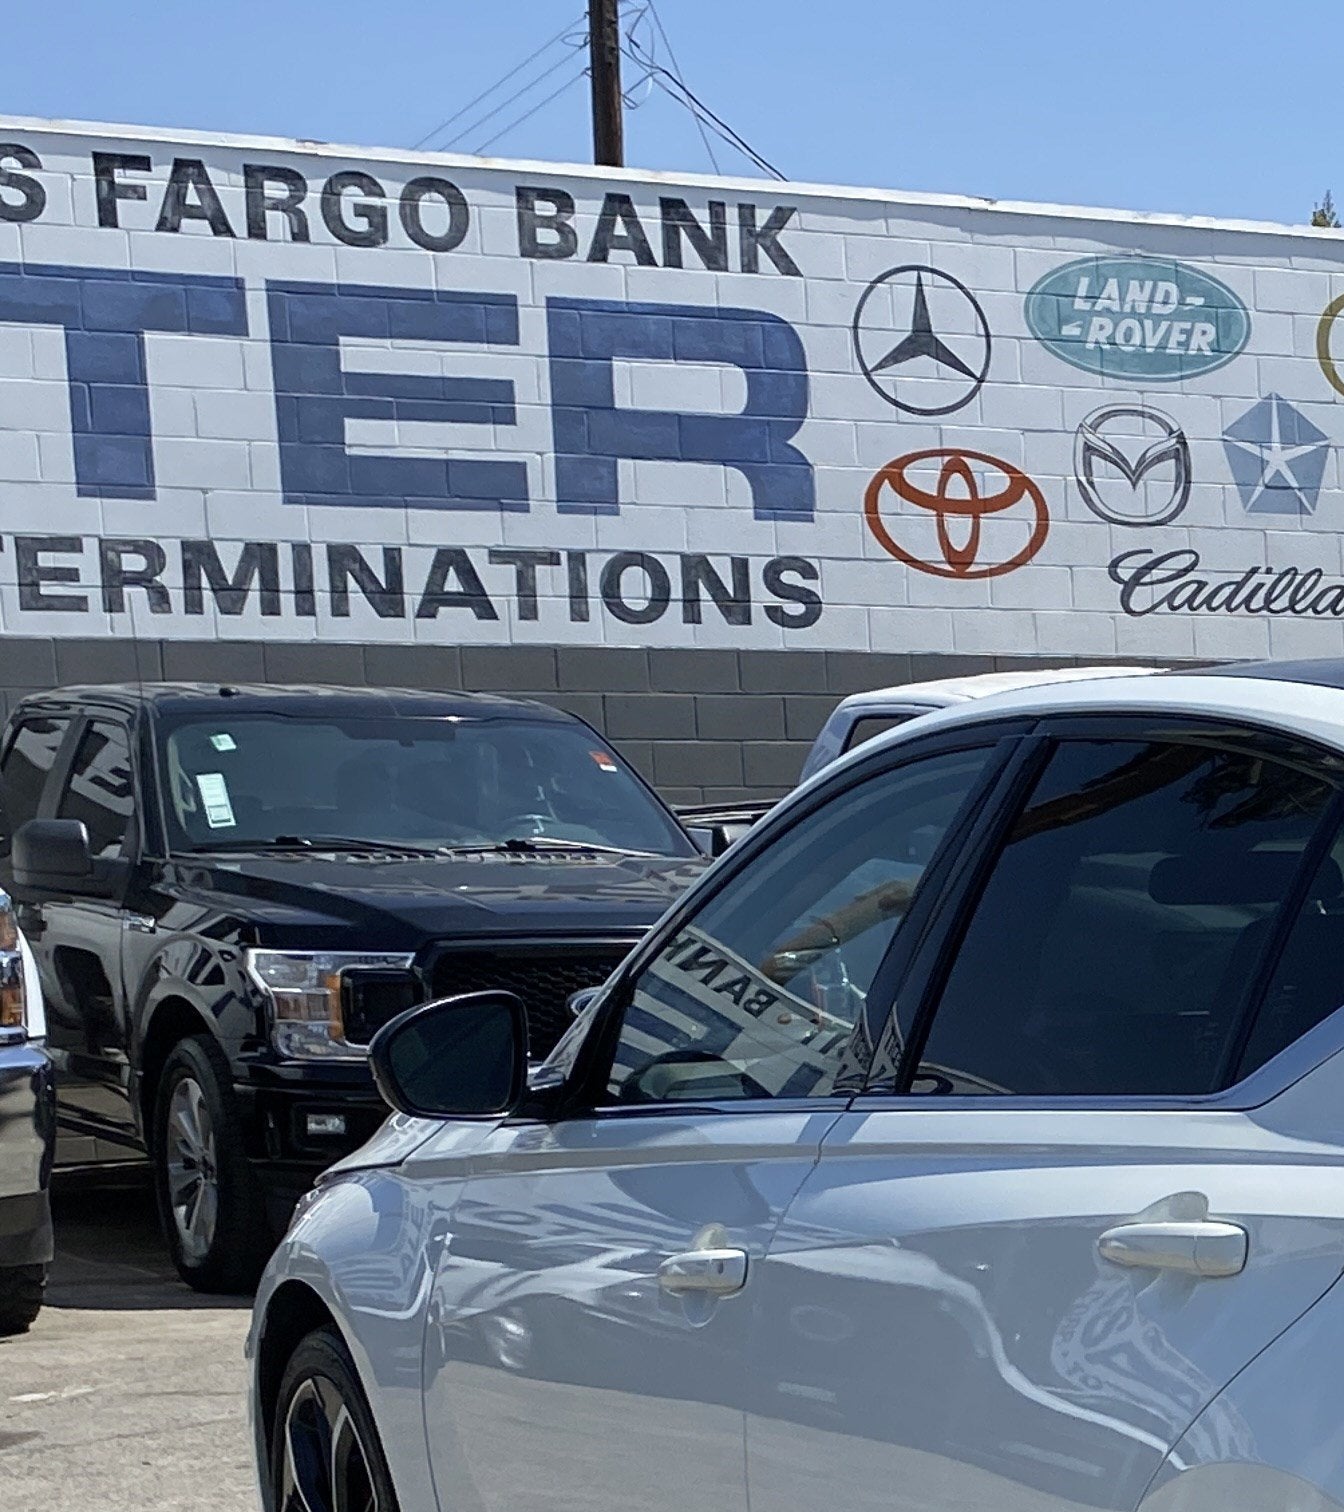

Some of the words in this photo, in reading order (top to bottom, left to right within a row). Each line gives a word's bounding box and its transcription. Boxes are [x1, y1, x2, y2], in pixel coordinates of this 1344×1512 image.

[91, 150, 470, 253] FARGO
[516, 185, 803, 277] BANK
[1085, 316, 1216, 355] ROVER
[0, 261, 816, 522] TER
[0, 534, 824, 630] ERMINATIONS
